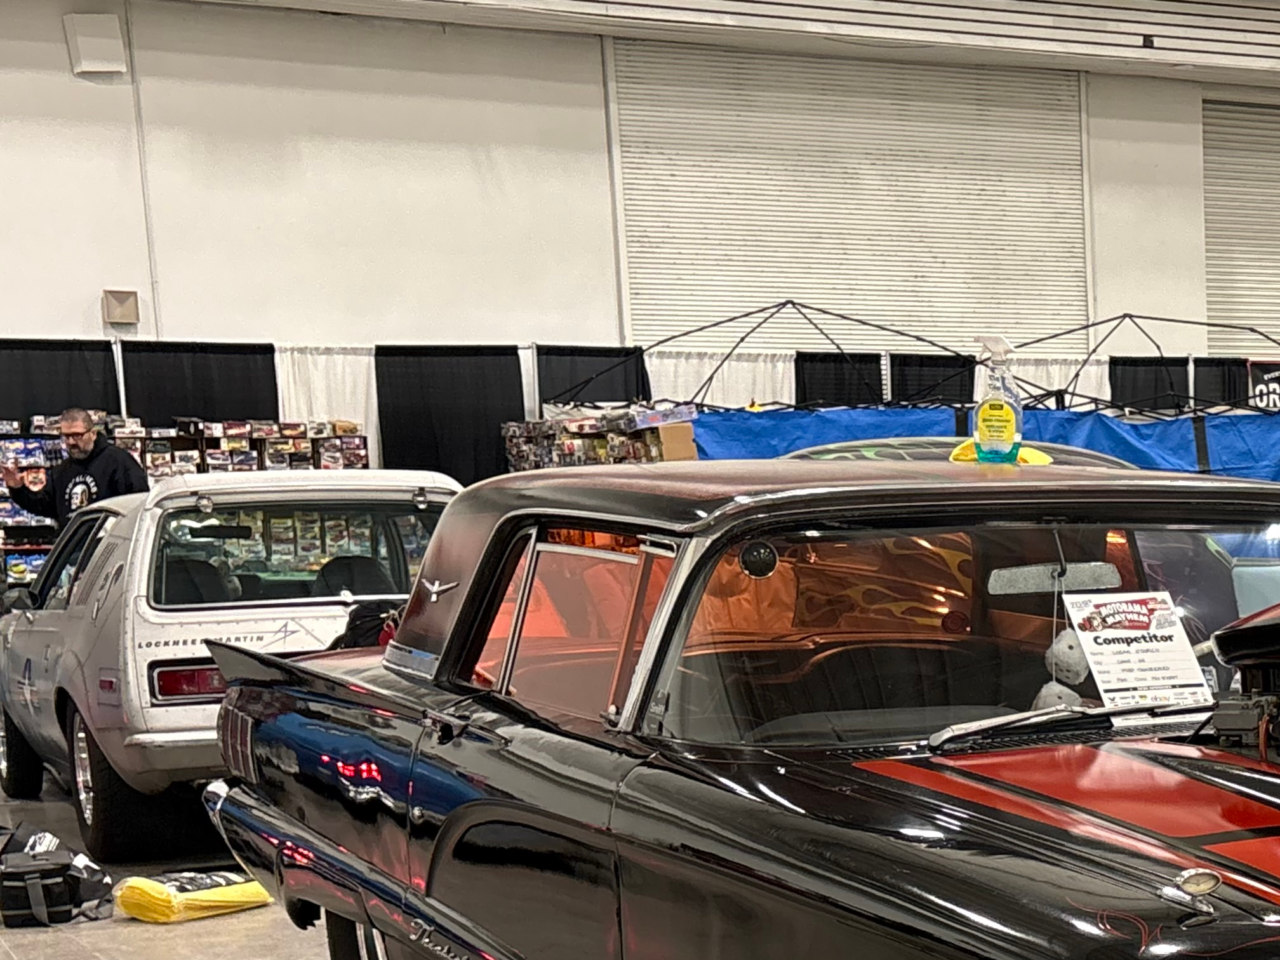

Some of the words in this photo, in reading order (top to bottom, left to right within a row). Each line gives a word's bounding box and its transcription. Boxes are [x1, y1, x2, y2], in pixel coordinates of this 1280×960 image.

[1099, 602, 1149, 615] MOTORAMA
[1105, 613, 1150, 625] MAYHEM
[1093, 632, 1174, 647] Competitor
